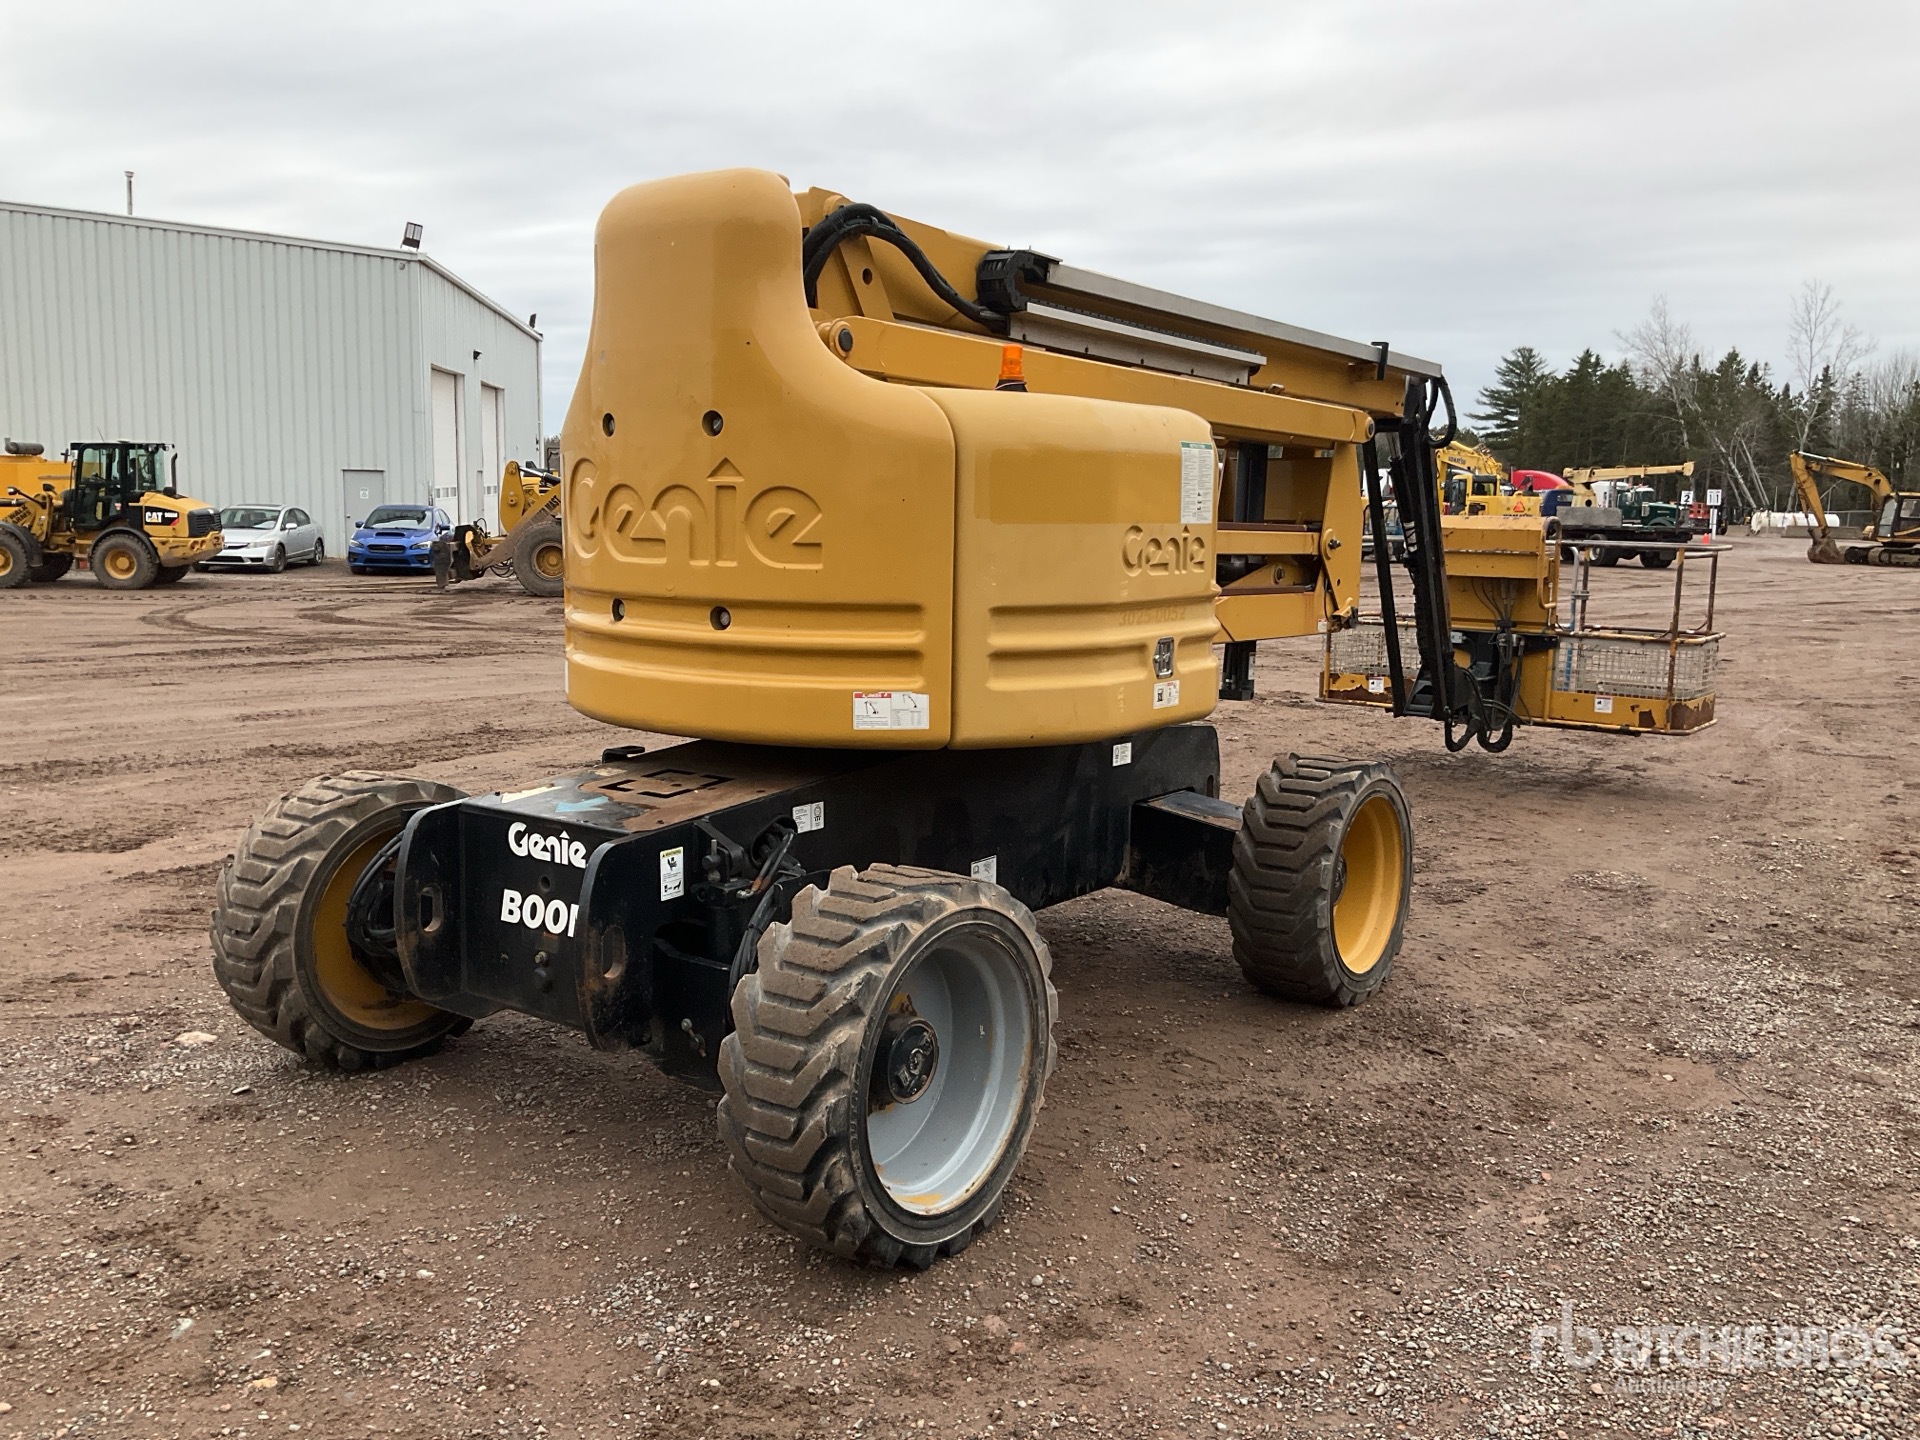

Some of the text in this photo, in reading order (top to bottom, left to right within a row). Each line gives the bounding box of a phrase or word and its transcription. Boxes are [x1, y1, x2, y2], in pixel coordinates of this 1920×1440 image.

[145, 511, 163, 523] CAT
[569, 457, 824, 570] Genie
[1683, 494, 1691, 503] 2
[1121, 525, 1206, 577] Genie
[507, 821, 587, 869] Genie
